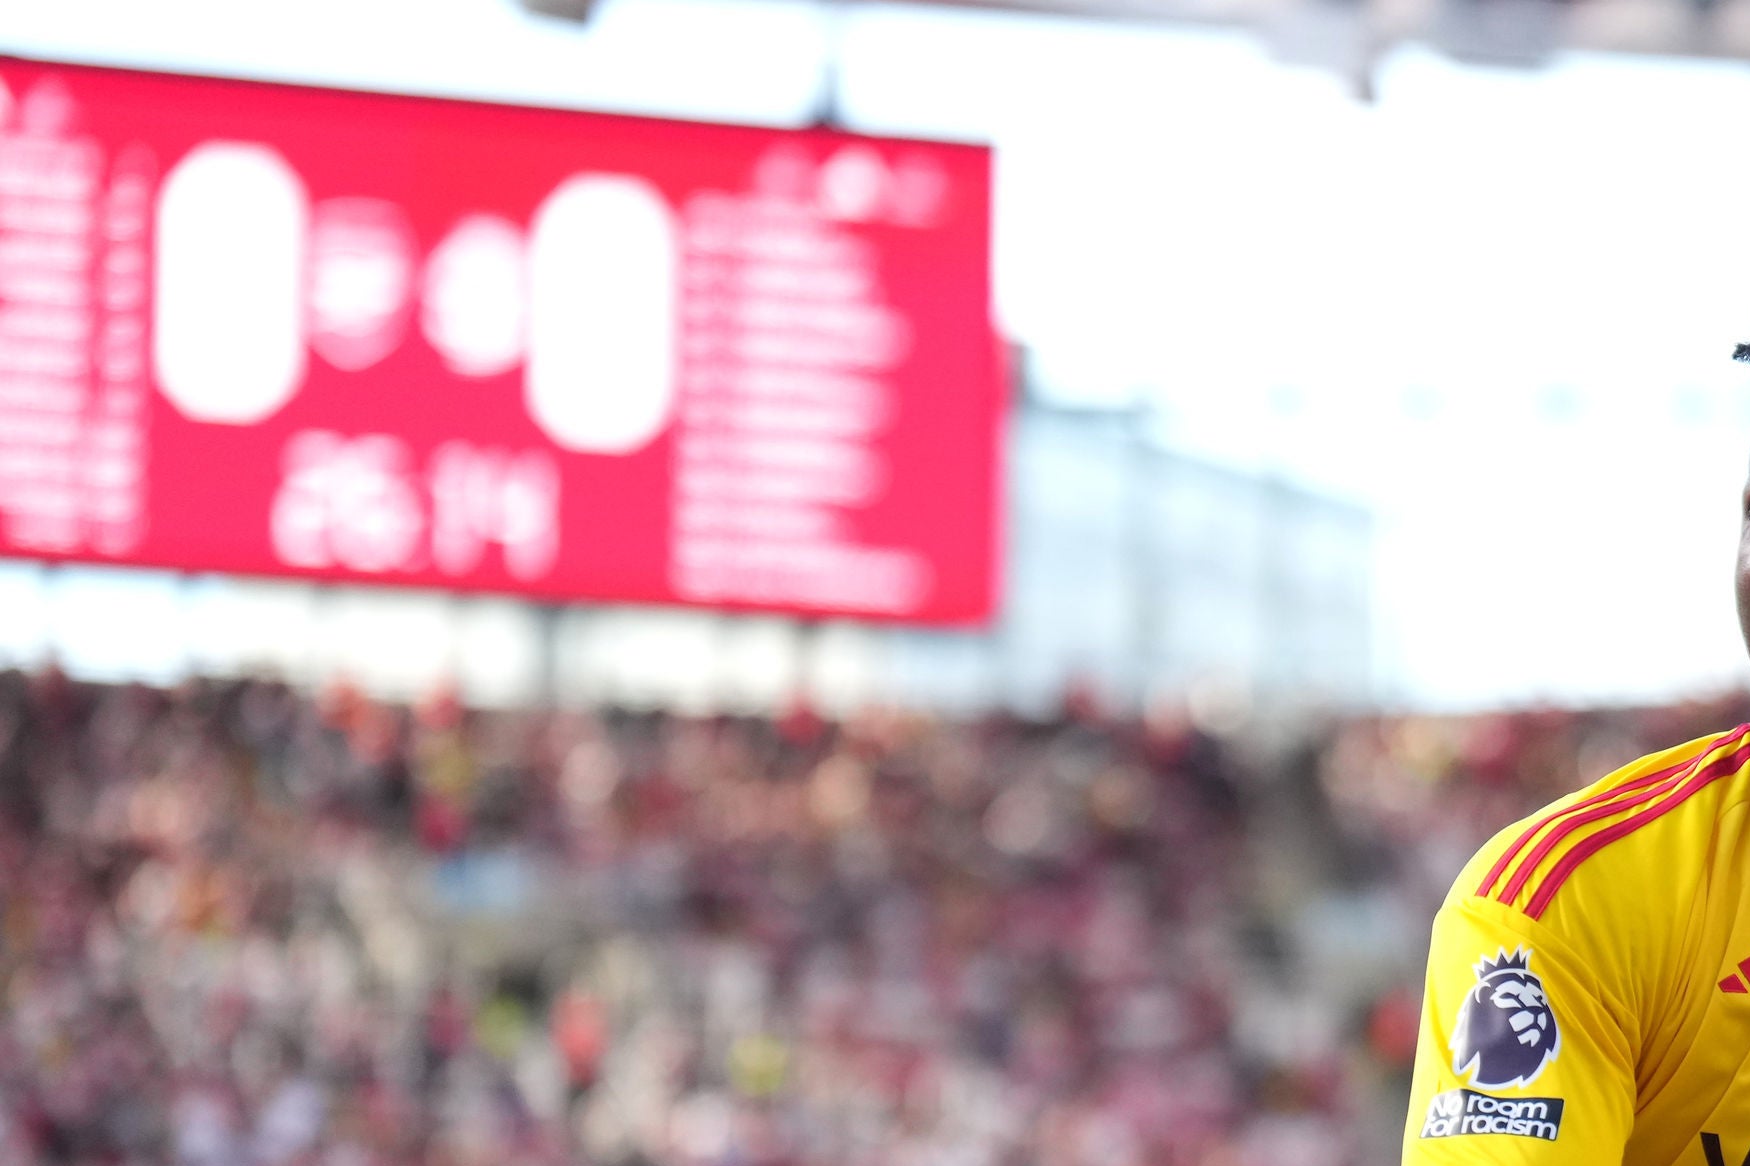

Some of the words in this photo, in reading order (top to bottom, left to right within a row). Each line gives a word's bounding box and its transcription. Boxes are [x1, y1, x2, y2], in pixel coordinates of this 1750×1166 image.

[1428, 1092, 1464, 1118] No
[1466, 1094, 1549, 1120] room
[1420, 1115, 1460, 1139] for
[1460, 1114, 1558, 1141] racism
